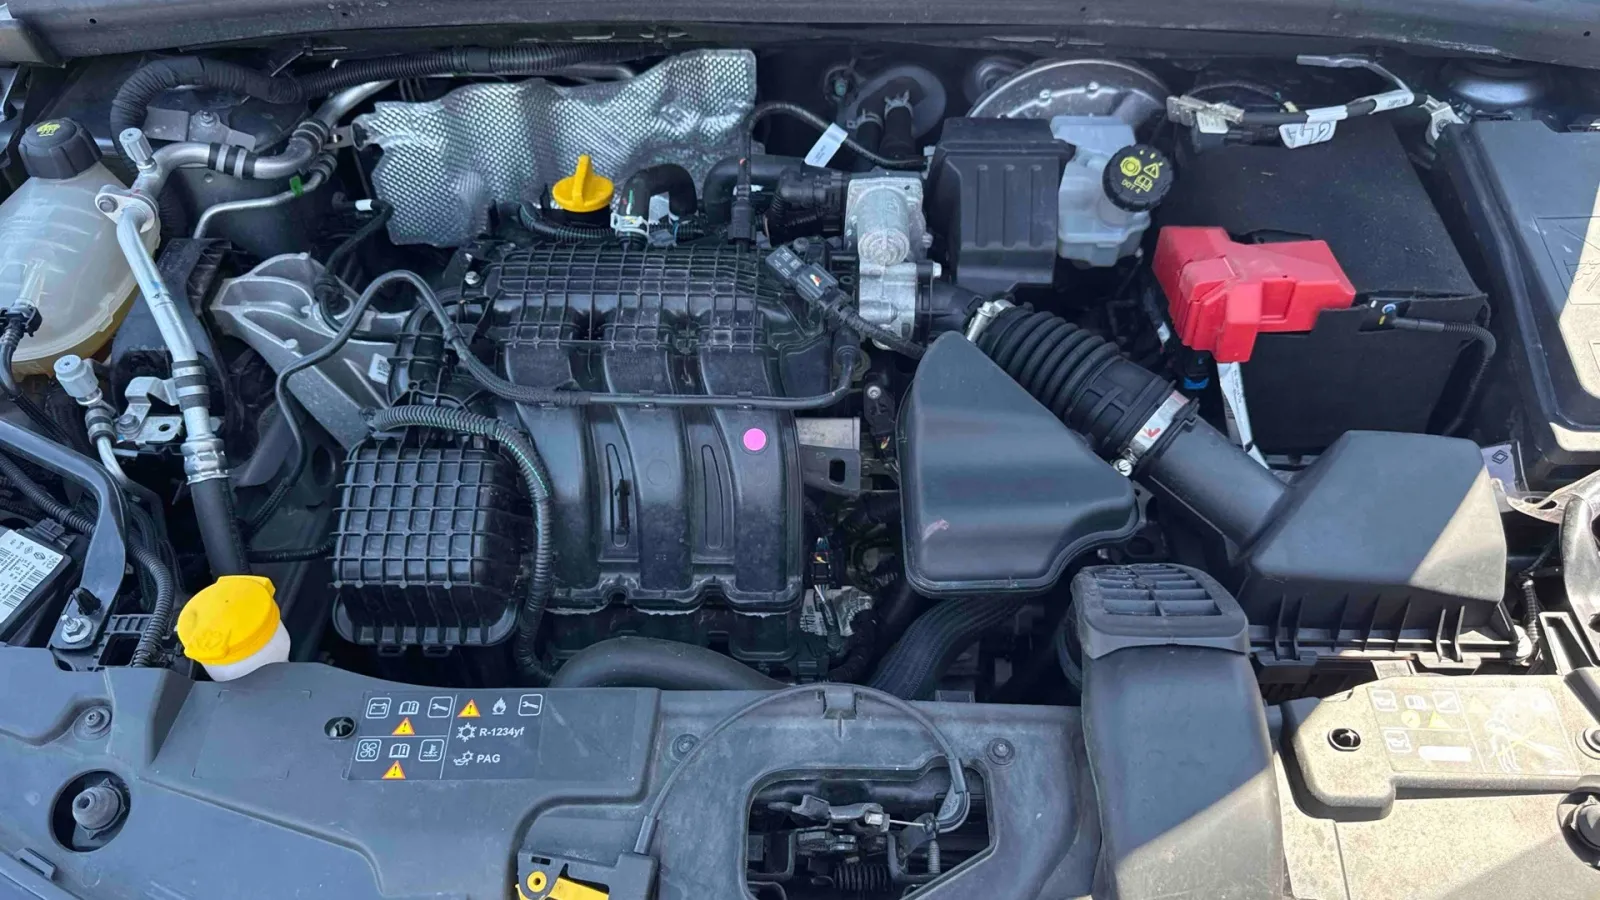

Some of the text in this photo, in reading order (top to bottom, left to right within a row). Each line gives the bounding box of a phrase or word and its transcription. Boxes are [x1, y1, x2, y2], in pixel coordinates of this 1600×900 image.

[1121, 178, 1136, 191] DOT
[479, 726, 525, 738] R-1234yf
[476, 753, 501, 764] PAG
